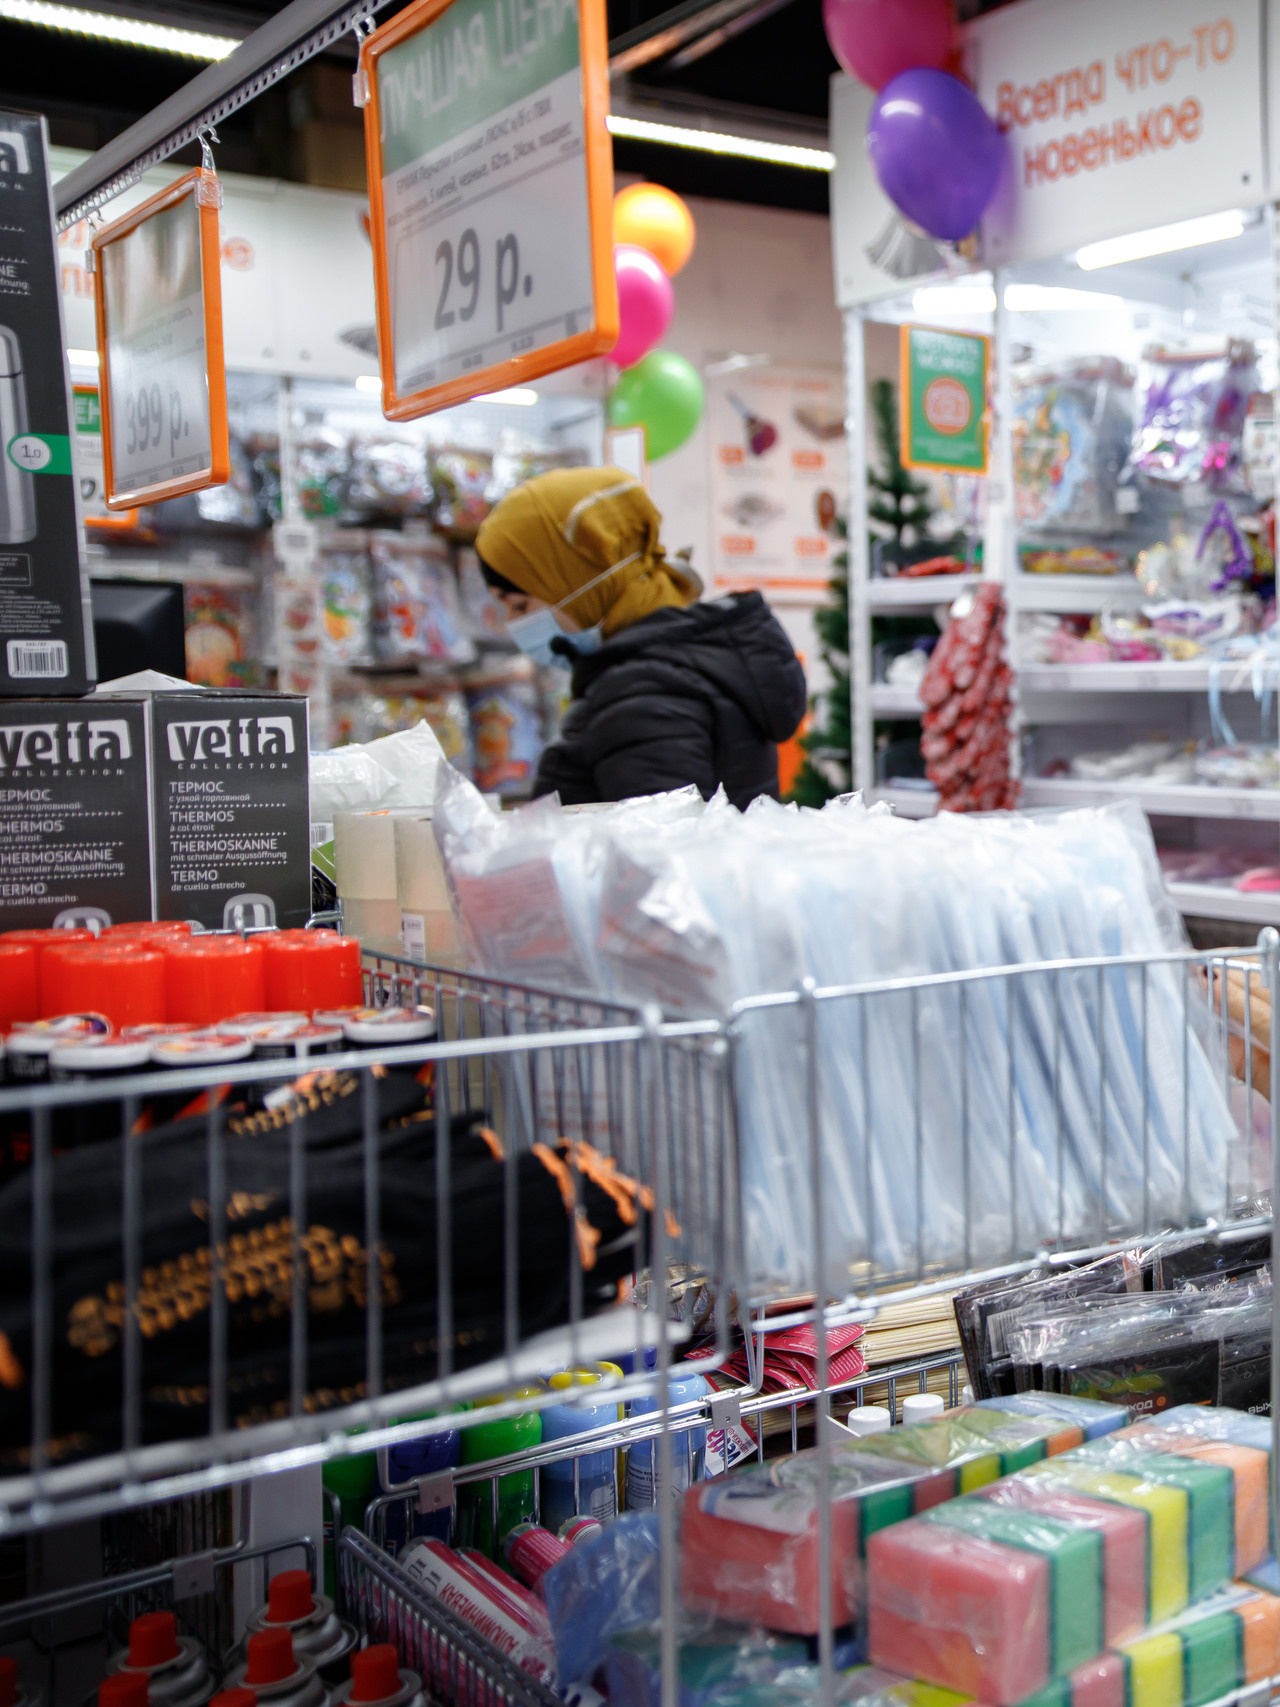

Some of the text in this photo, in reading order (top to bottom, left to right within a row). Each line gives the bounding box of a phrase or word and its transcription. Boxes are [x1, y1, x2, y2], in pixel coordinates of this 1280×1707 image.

[997, 16, 1236, 133] Всегда что-то
[1023, 95, 1203, 188] новенькое
[434, 228, 533, 333] 29 р.
[126, 382, 189, 459] 399 р.
[0, 721, 122, 768] vetta
[170, 717, 289, 761] vetta
[177, 762, 288, 770] COLLECTION
[169, 781, 225, 793] ТЕРМОС
[0, 789, 52, 801] ЕРМОС
[176, 794, 200, 804] узкой
[202, 793, 250, 803] горловиной
[170, 810, 235, 823] THERMOS
[0, 819, 65, 834] HERMOS
[177, 823, 190, 832] col
[192, 823, 215, 831] étroit
[170, 838, 278, 853] THERMOSKANNE
[0, 848, 114, 865] HERMOSKANNE
[170, 851, 287, 862] mit schmaler Ausgussöffnung
[10, 865, 51, 875] schmaler
[54, 862, 124, 874] Ausgussöffnung
[171, 869, 218, 882] TERMO
[171, 881, 246, 891] de cuello estrecho
[440, 1582, 519, 1656] АЛЮМИНИЕВАЯ
